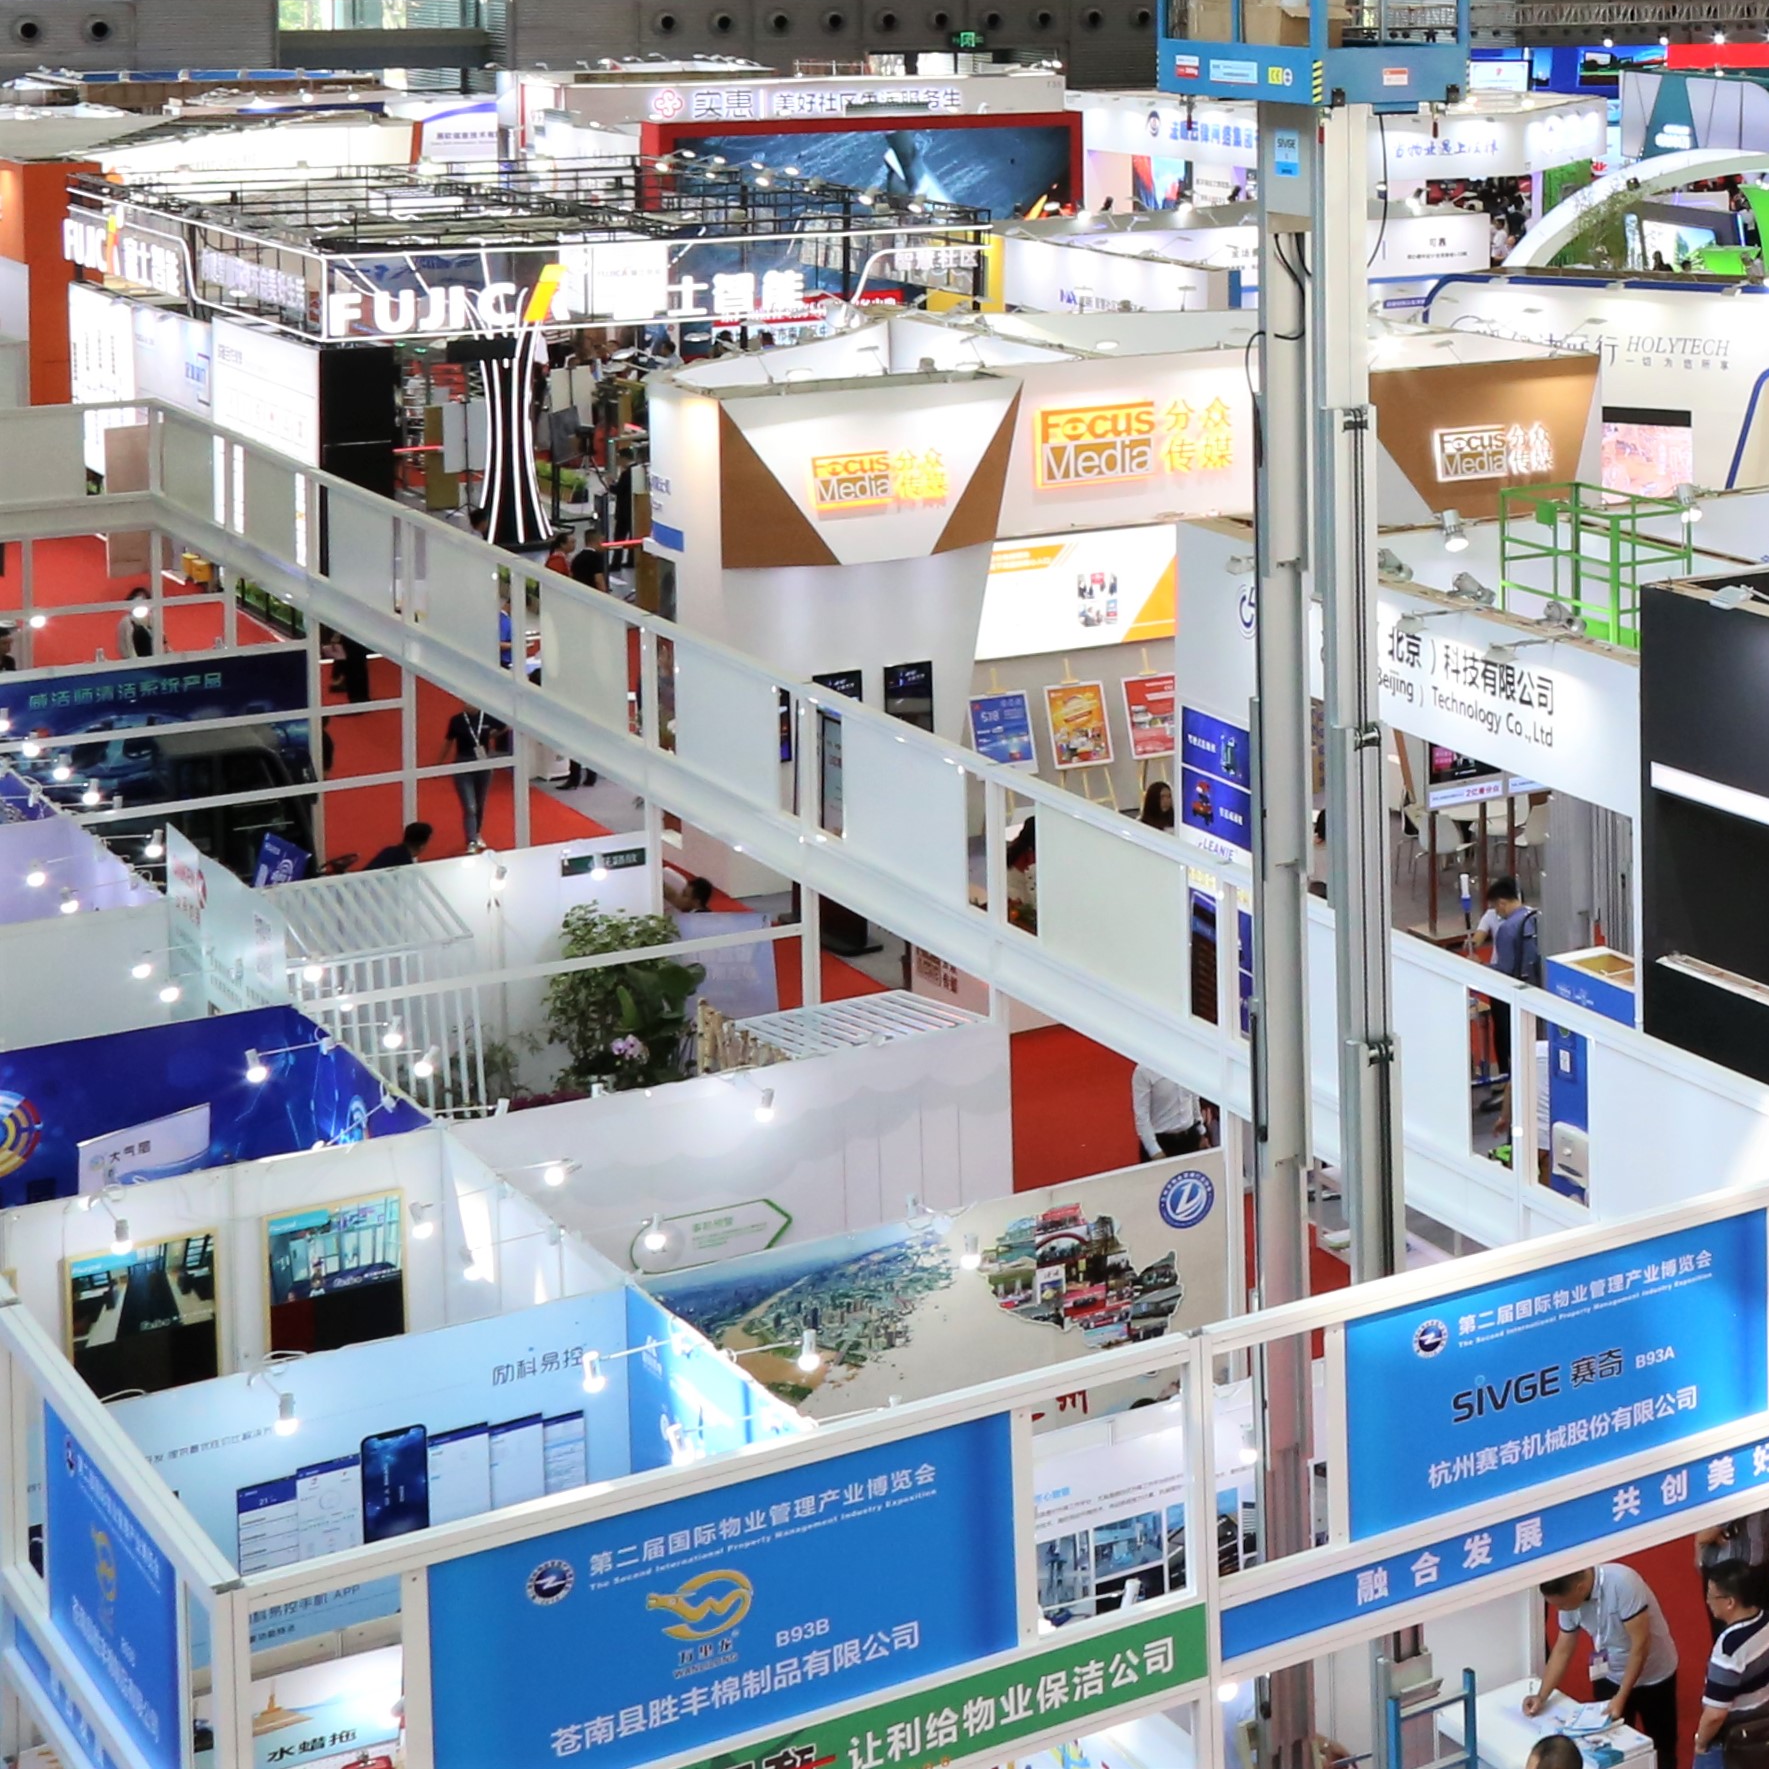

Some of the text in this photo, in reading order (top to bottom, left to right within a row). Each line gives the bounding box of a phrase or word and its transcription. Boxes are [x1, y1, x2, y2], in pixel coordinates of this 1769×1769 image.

[1626, 335, 1730, 357] HOLYTECH
[1044, 441, 1153, 482] Media
[1431, 686, 1502, 734] Technology
[1443, 643, 1556, 717] 科技有限公司
[1458, 1250, 1712, 1336] 第二届国际物业管理产业博览会
[1635, 1346, 1675, 1368] B93A
[1427, 1385, 1699, 1490] 杭州赛奇机械股份有限公司
[589, 1463, 936, 1577] 第二届国际物业管理产业博览会
[775, 1618, 830, 1647] B93B
[550, 1620, 920, 1759] 苍南县胜丰棉制品有限公司
[848, 1635, 1177, 1769] 让利给物业保洁公司
